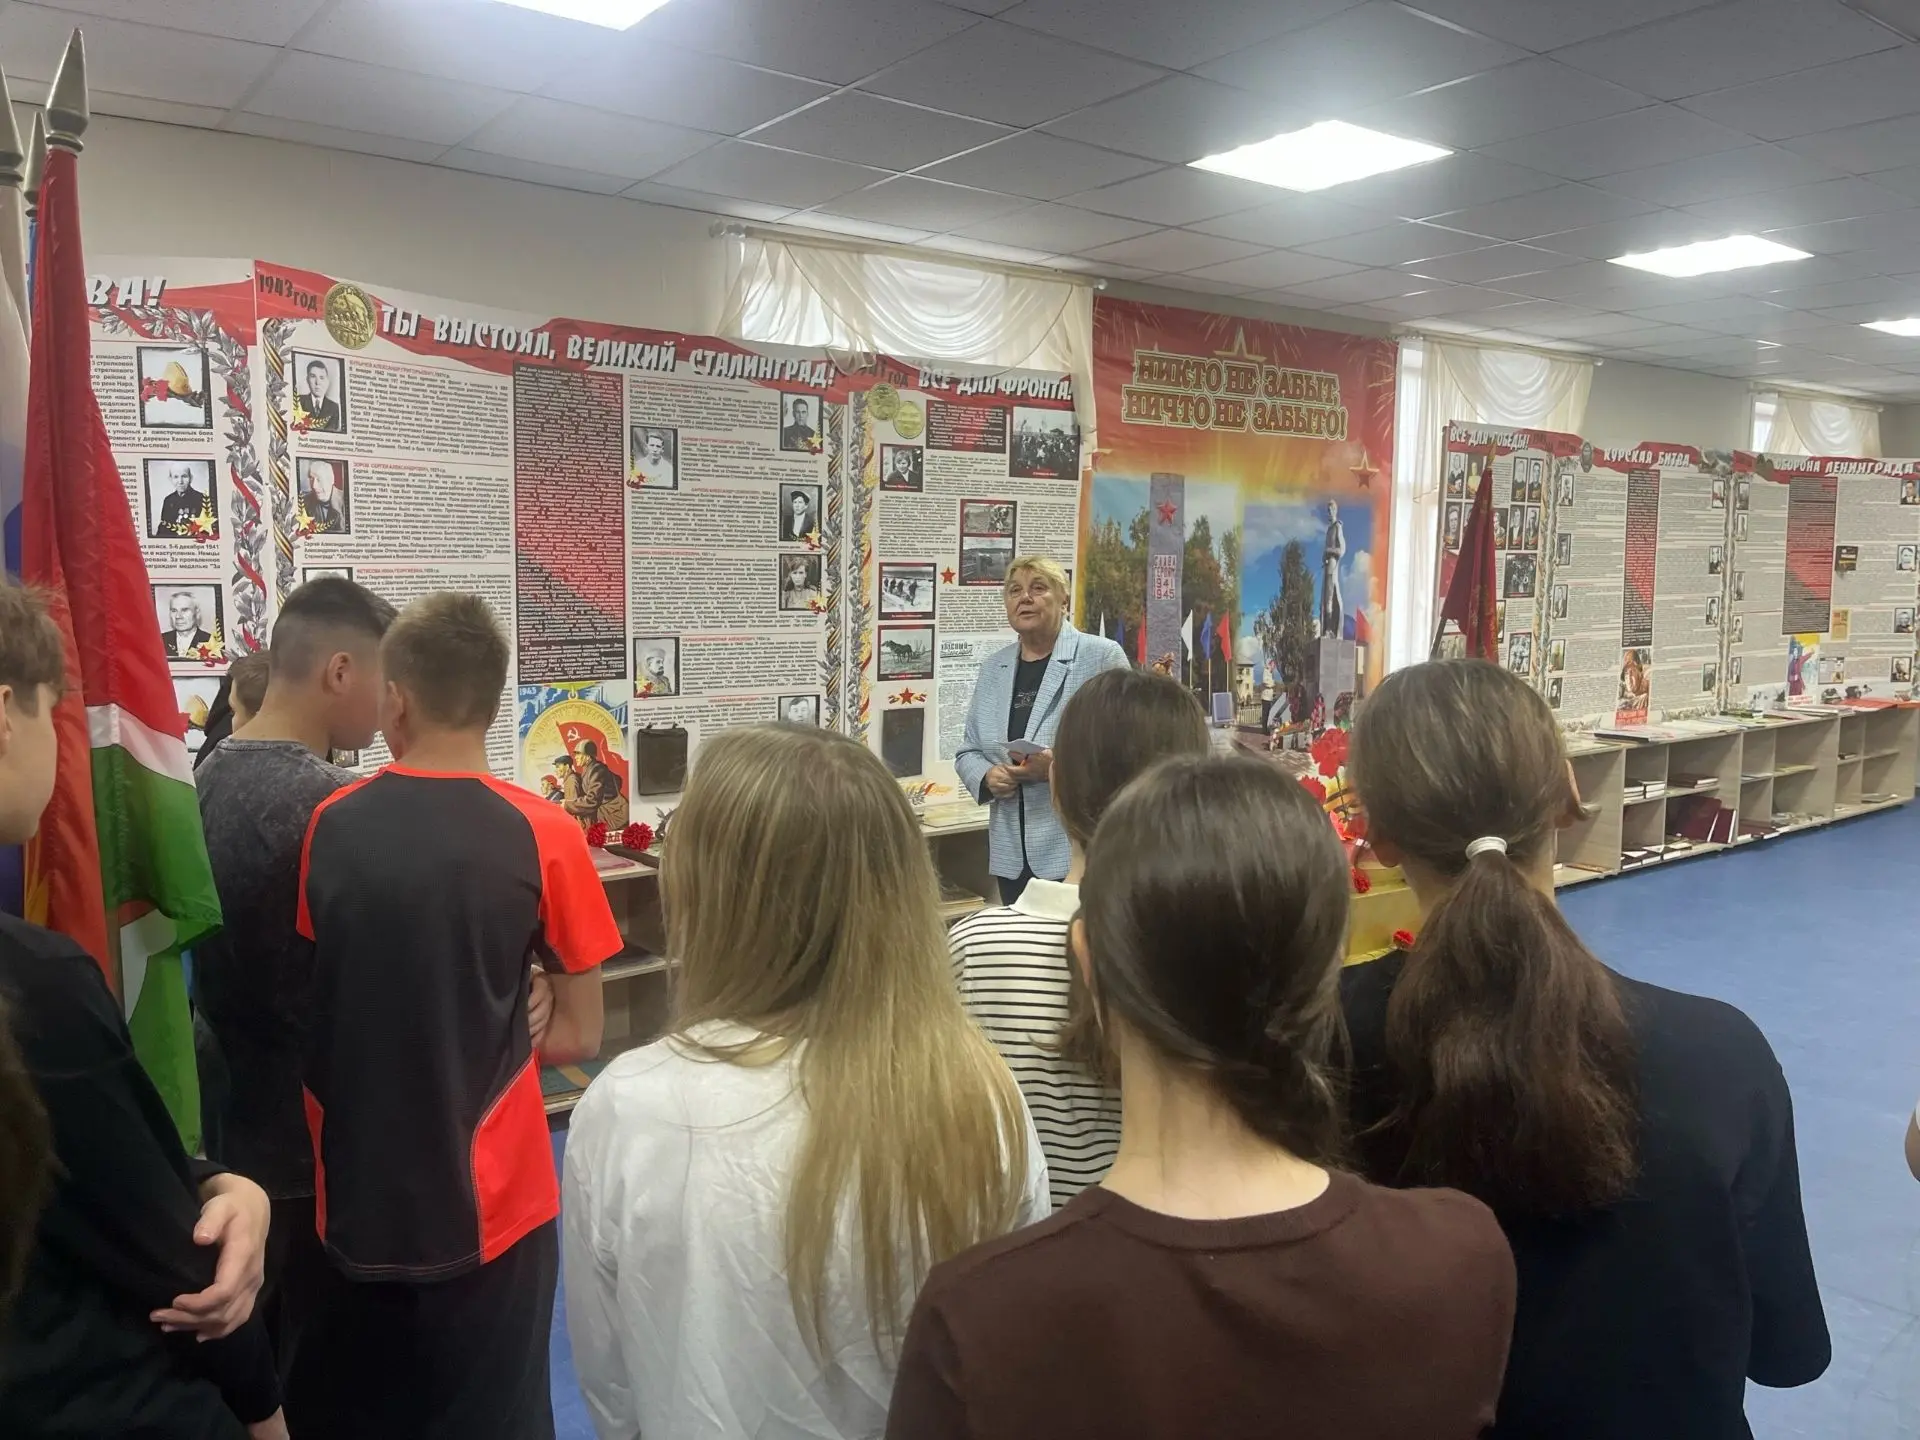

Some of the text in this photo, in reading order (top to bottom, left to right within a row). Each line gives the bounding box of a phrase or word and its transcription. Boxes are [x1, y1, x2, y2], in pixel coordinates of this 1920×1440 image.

[259, 274, 292, 297] 1943
[381, 304, 420, 337] ТЫ
[434, 313, 556, 360] ВЫСТОЯЛ,
[567, 329, 677, 374] ВЕЛИКИЙ
[689, 348, 837, 389] СТАЛИНГРАД!
[918, 367, 1073, 400] ВСЕ ДЛЯ ФРОНТА!
[1136, 351, 1339, 406] НИКТО НЕ ЗАБЫТ,
[1124, 386, 1348, 439] НИЧТО НЕ ЗАБЫТО!
[1450, 426, 1466, 443] ВСЕ
[1468, 431, 1489, 447] ДЛЯ
[1603, 448, 1690, 468] КУРСКАЯ БИТВА
[1774, 458, 1914, 476] ОБОРОНА ЛЕНИНГРАДА
